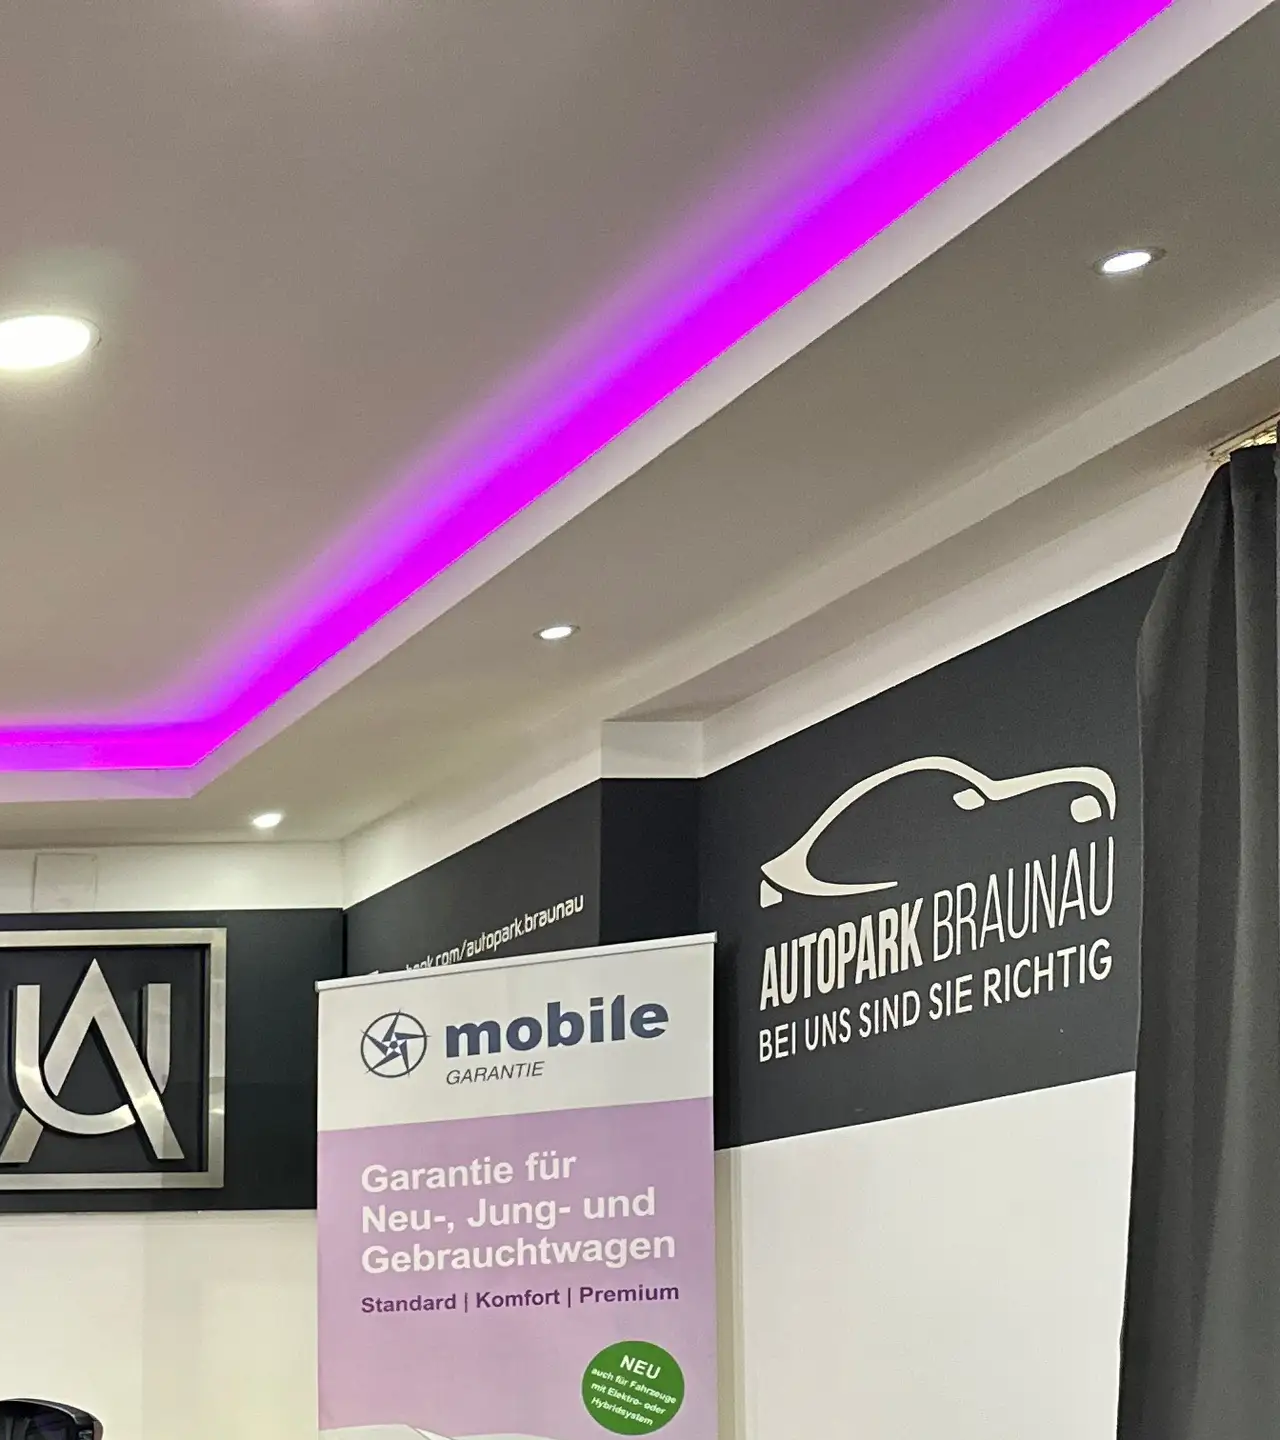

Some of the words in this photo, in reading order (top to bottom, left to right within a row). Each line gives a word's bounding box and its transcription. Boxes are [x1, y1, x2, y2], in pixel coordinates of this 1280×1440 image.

[759, 897, 924, 1012] AUTOPARK
[933, 836, 1115, 963] BRAUNAU
[759, 1026, 797, 1063] BEI
[805, 1007, 852, 1052] UNS
[859, 989, 921, 1038] SIND
[929, 974, 973, 1021] SIE
[983, 938, 1113, 1008] RICHTIG
[445, 995, 669, 1058] mobile
[446, 1061, 545, 1085] GARANTIE
[361, 1156, 514, 1193] Garantie
[525, 1151, 577, 1182] für
[362, 1205, 455, 1235] Neu-,
[467, 1197, 571, 1231] Jung-
[584, 1187, 656, 1218] und
[361, 1233, 676, 1274] Gebrauchtwagen
[361, 1294, 457, 1314] Standard
[476, 1288, 560, 1309] Komfort
[579, 1284, 680, 1304] Premium
[591, 1367, 614, 1381] auch
[615, 1375, 629, 1386] für
[630, 1380, 677, 1404] Fahrzeuge
[620, 1354, 661, 1379] NEU
[591, 1382, 607, 1394] mit
[608, 1387, 643, 1406] Elektro-
[644, 1402, 666, 1415] oder
[591, 1396, 654, 1427] Hybridsystem
